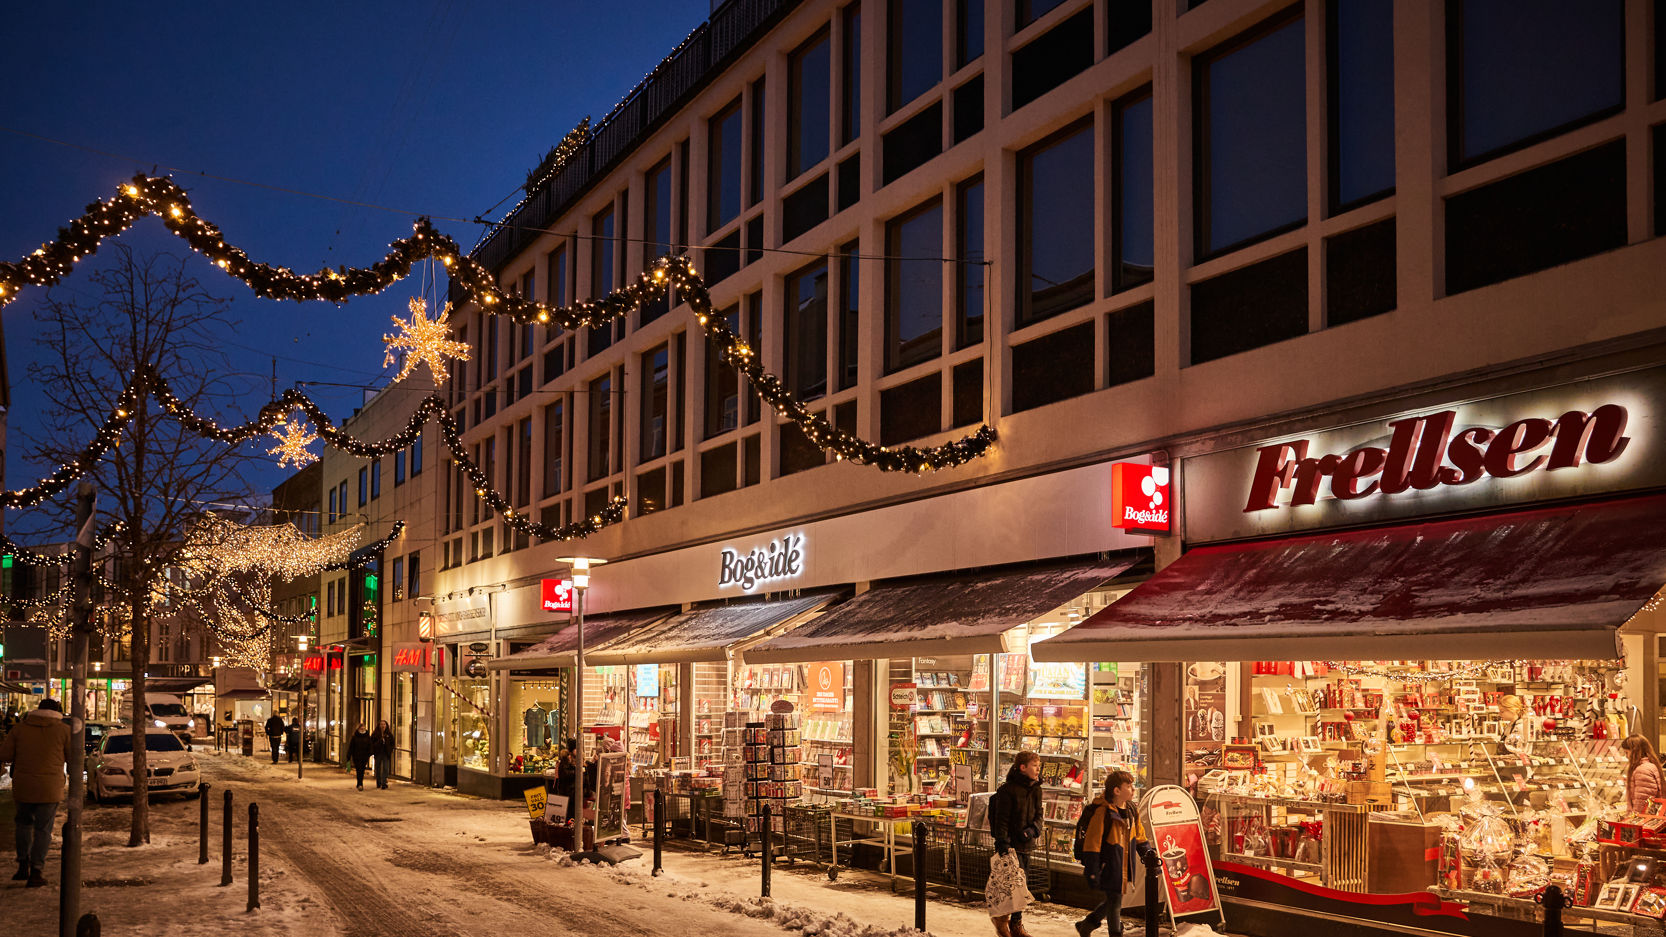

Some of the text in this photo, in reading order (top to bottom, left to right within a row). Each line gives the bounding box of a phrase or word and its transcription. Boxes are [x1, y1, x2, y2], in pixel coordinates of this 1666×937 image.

[1243, 404, 1631, 513] Frellsen
[1124, 505, 1168, 524] Bog&idé
[718, 536, 801, 590] Bog&idé
[394, 648, 421, 666] H&M
[918, 657, 936, 666] Fantasy
[530, 802, 545, 812] 30
